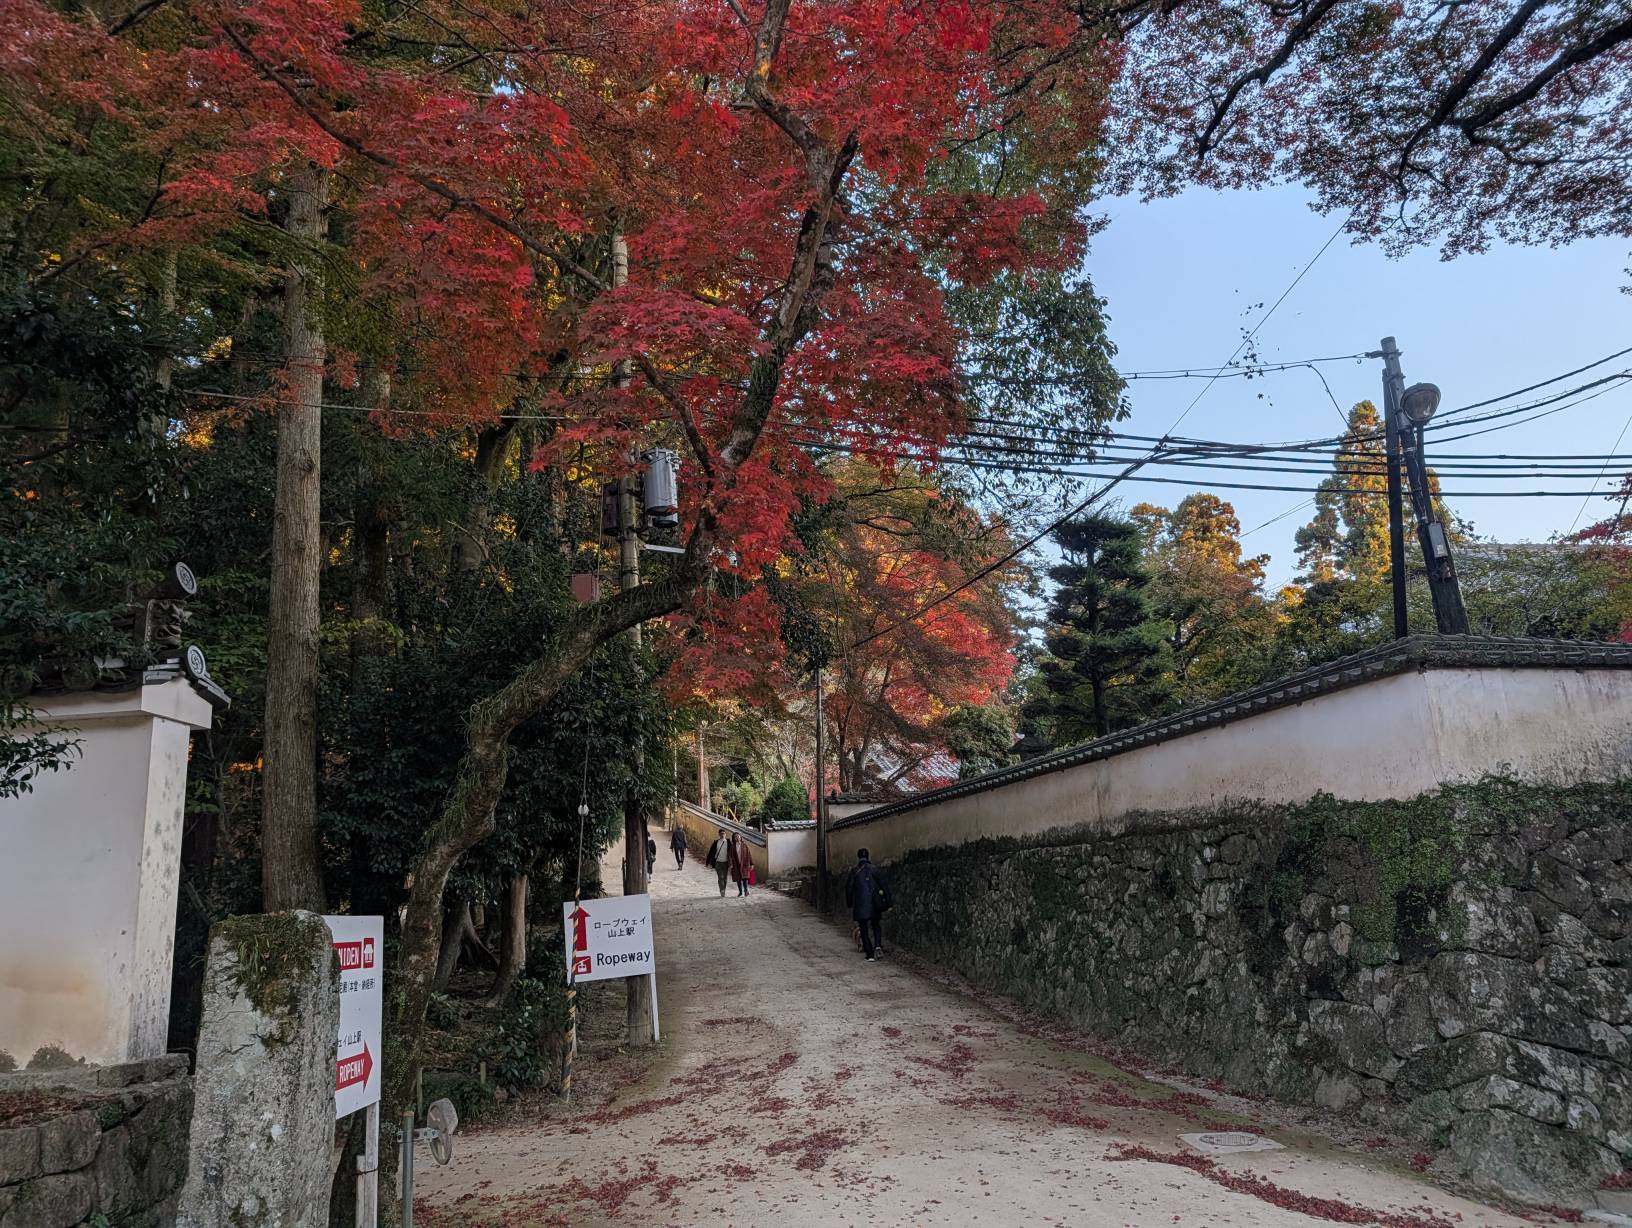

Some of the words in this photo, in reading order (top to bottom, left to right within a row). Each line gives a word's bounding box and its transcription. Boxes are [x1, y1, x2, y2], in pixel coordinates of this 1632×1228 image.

[594, 916, 646, 929] ロープウェイ
[607, 926, 636, 938] 山上駅
[596, 950, 651, 966] Ropeway
[339, 1058, 365, 1083] ROPEWAY
